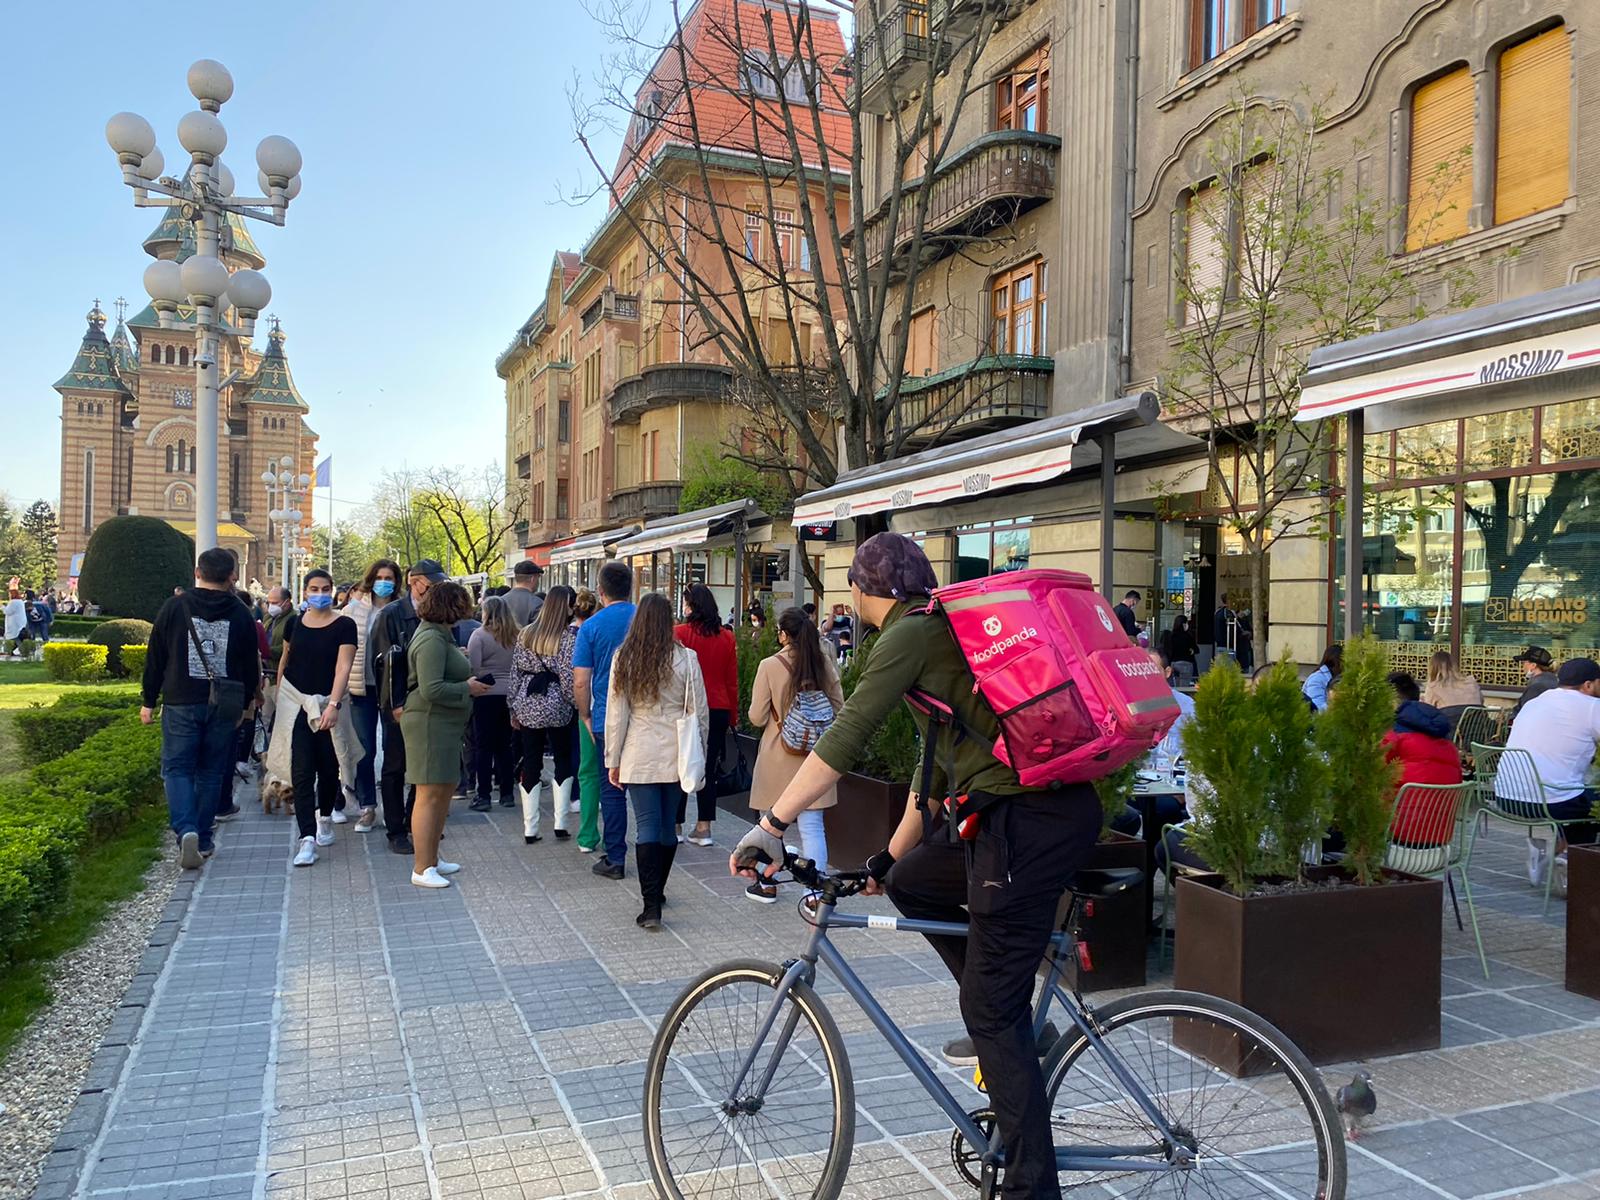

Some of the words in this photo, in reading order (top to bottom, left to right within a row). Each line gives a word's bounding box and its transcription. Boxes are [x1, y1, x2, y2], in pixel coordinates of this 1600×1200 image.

[1480, 349, 1564, 384] MASSIMO
[1522, 597, 1587, 611] GELATO
[1508, 610, 1524, 622] di
[1526, 610, 1587, 624] BRUNO
[973, 625, 1038, 665] foodpanda
